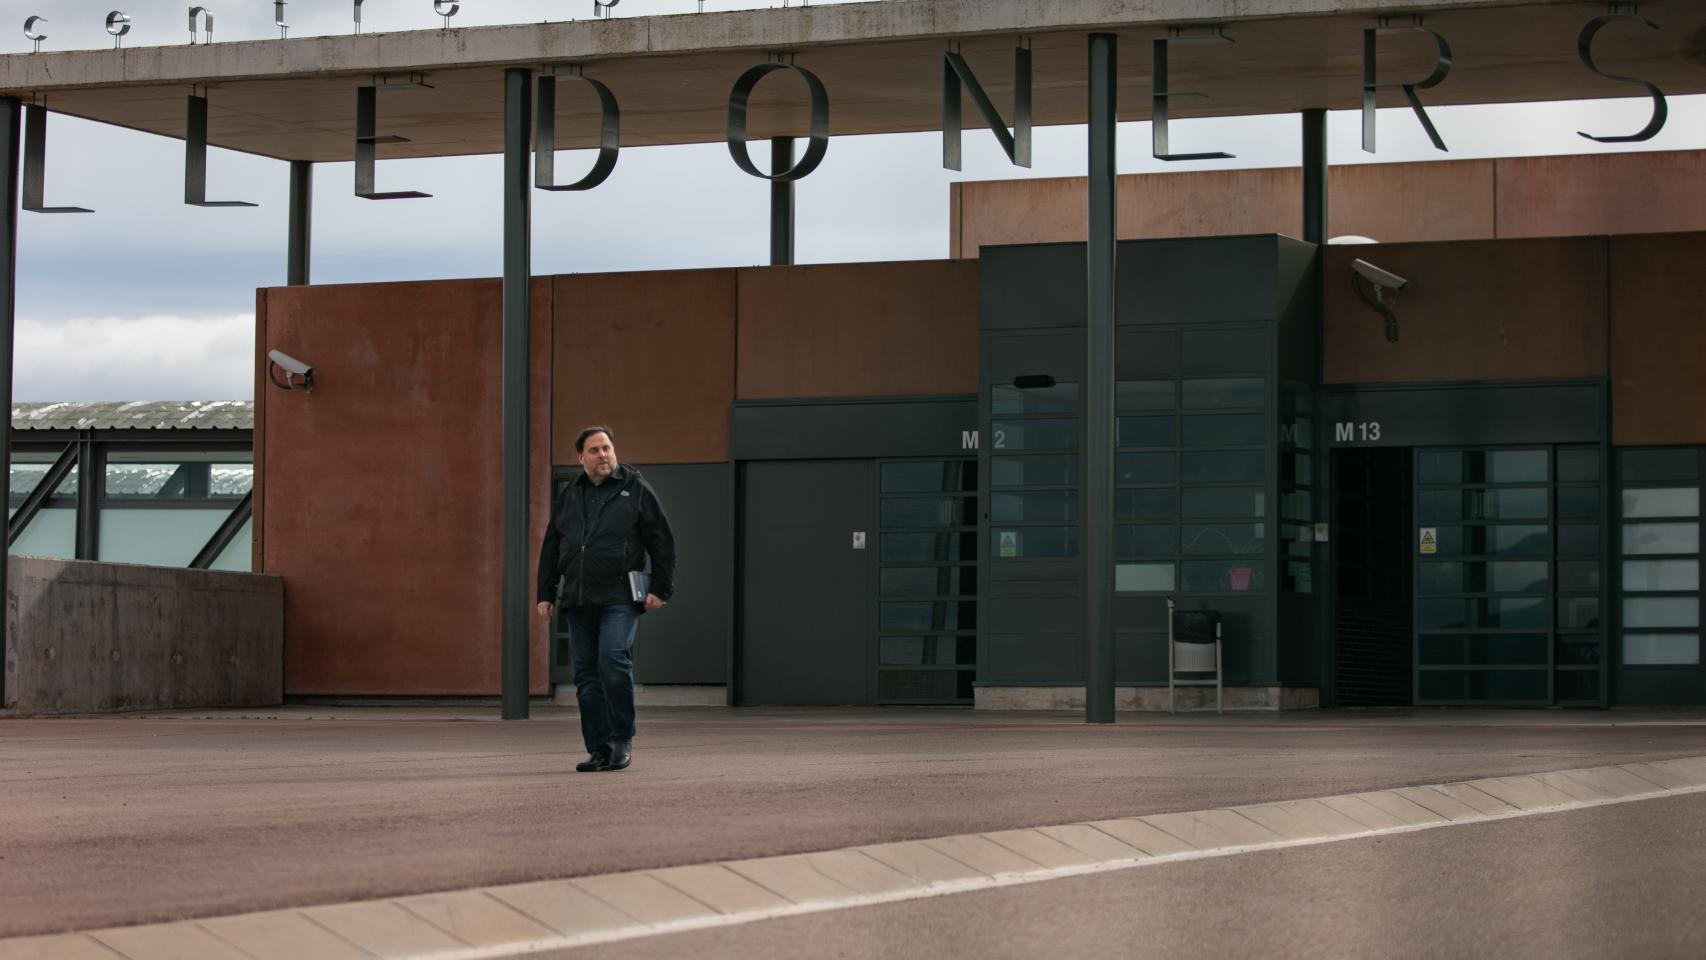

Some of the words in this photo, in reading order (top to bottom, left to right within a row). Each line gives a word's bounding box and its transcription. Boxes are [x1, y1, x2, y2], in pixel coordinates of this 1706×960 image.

[22, 14, 1668, 213] LLEDONERS
[962, 430, 979, 449] M
[1335, 422, 1354, 442] M
[1359, 422, 1380, 441] 13
